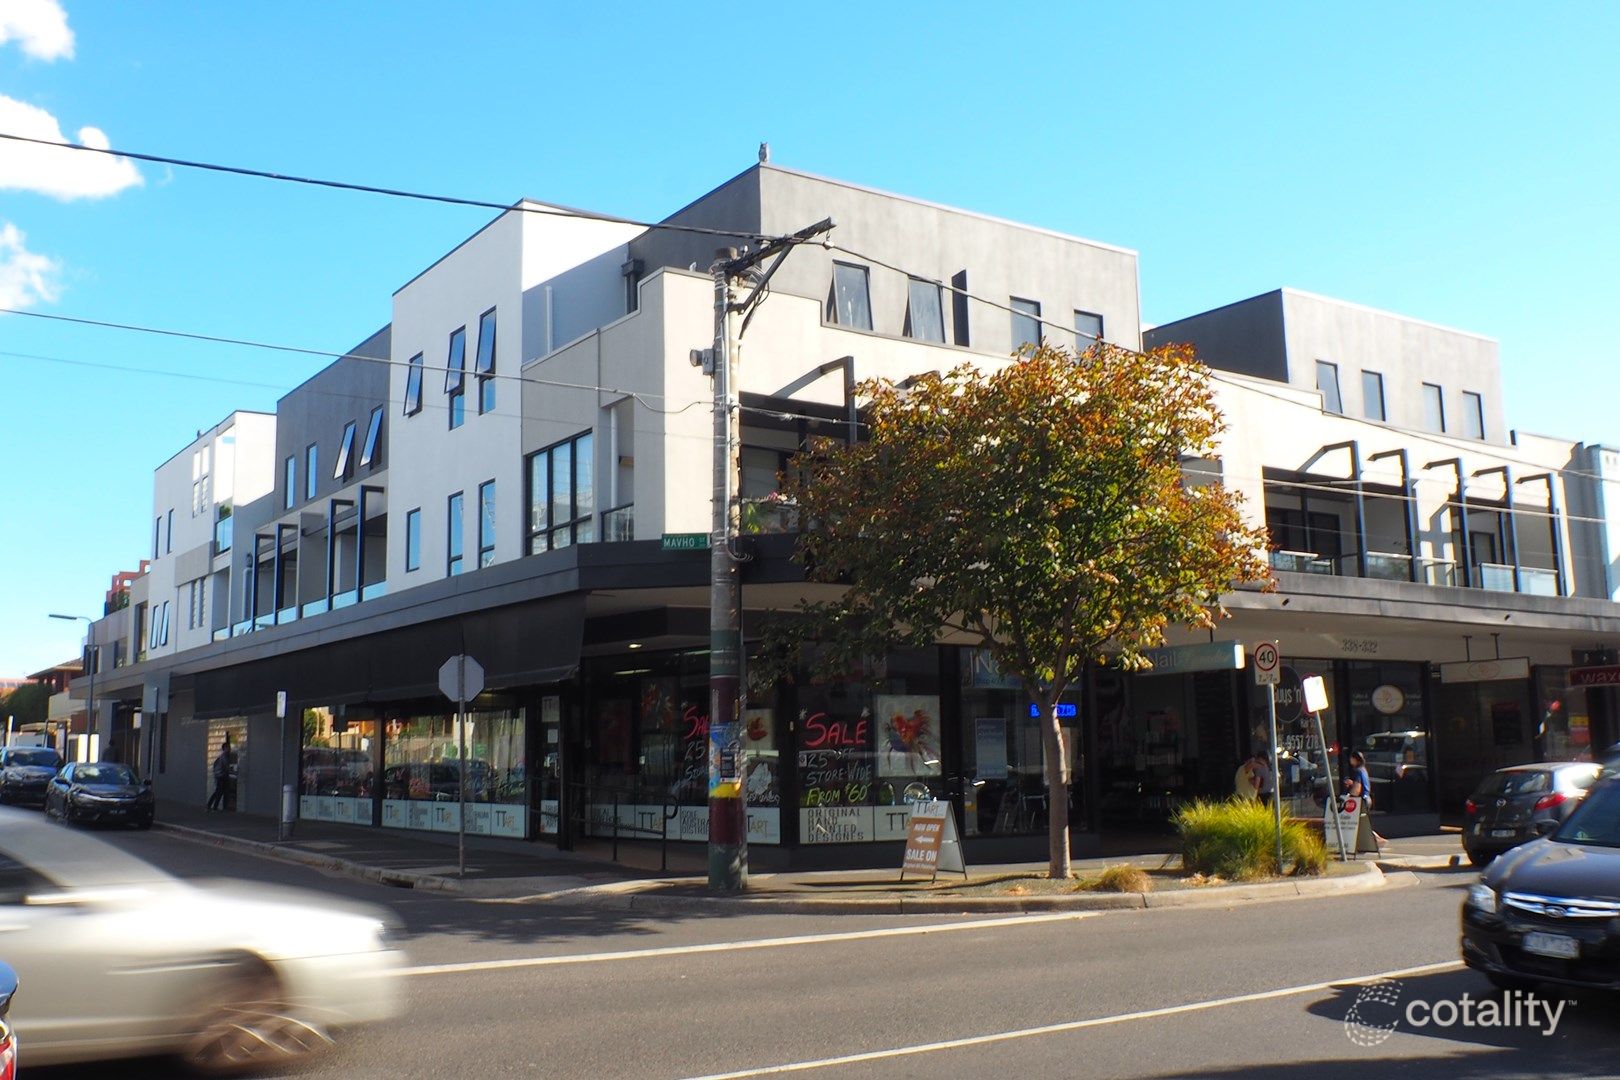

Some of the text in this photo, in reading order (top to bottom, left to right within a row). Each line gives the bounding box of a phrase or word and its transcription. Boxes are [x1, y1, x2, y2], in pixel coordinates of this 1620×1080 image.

[663, 537, 695, 548] MAVHO
[1259, 650, 1275, 664] 40
[804, 712, 867, 747] SALE
[805, 787, 841, 806] FROM
[807, 807, 862, 819] ORIGINAL
[807, 817, 838, 826] HAND
[807, 824, 858, 834] PAINTED
[906, 848, 937, 862] SALE ON
